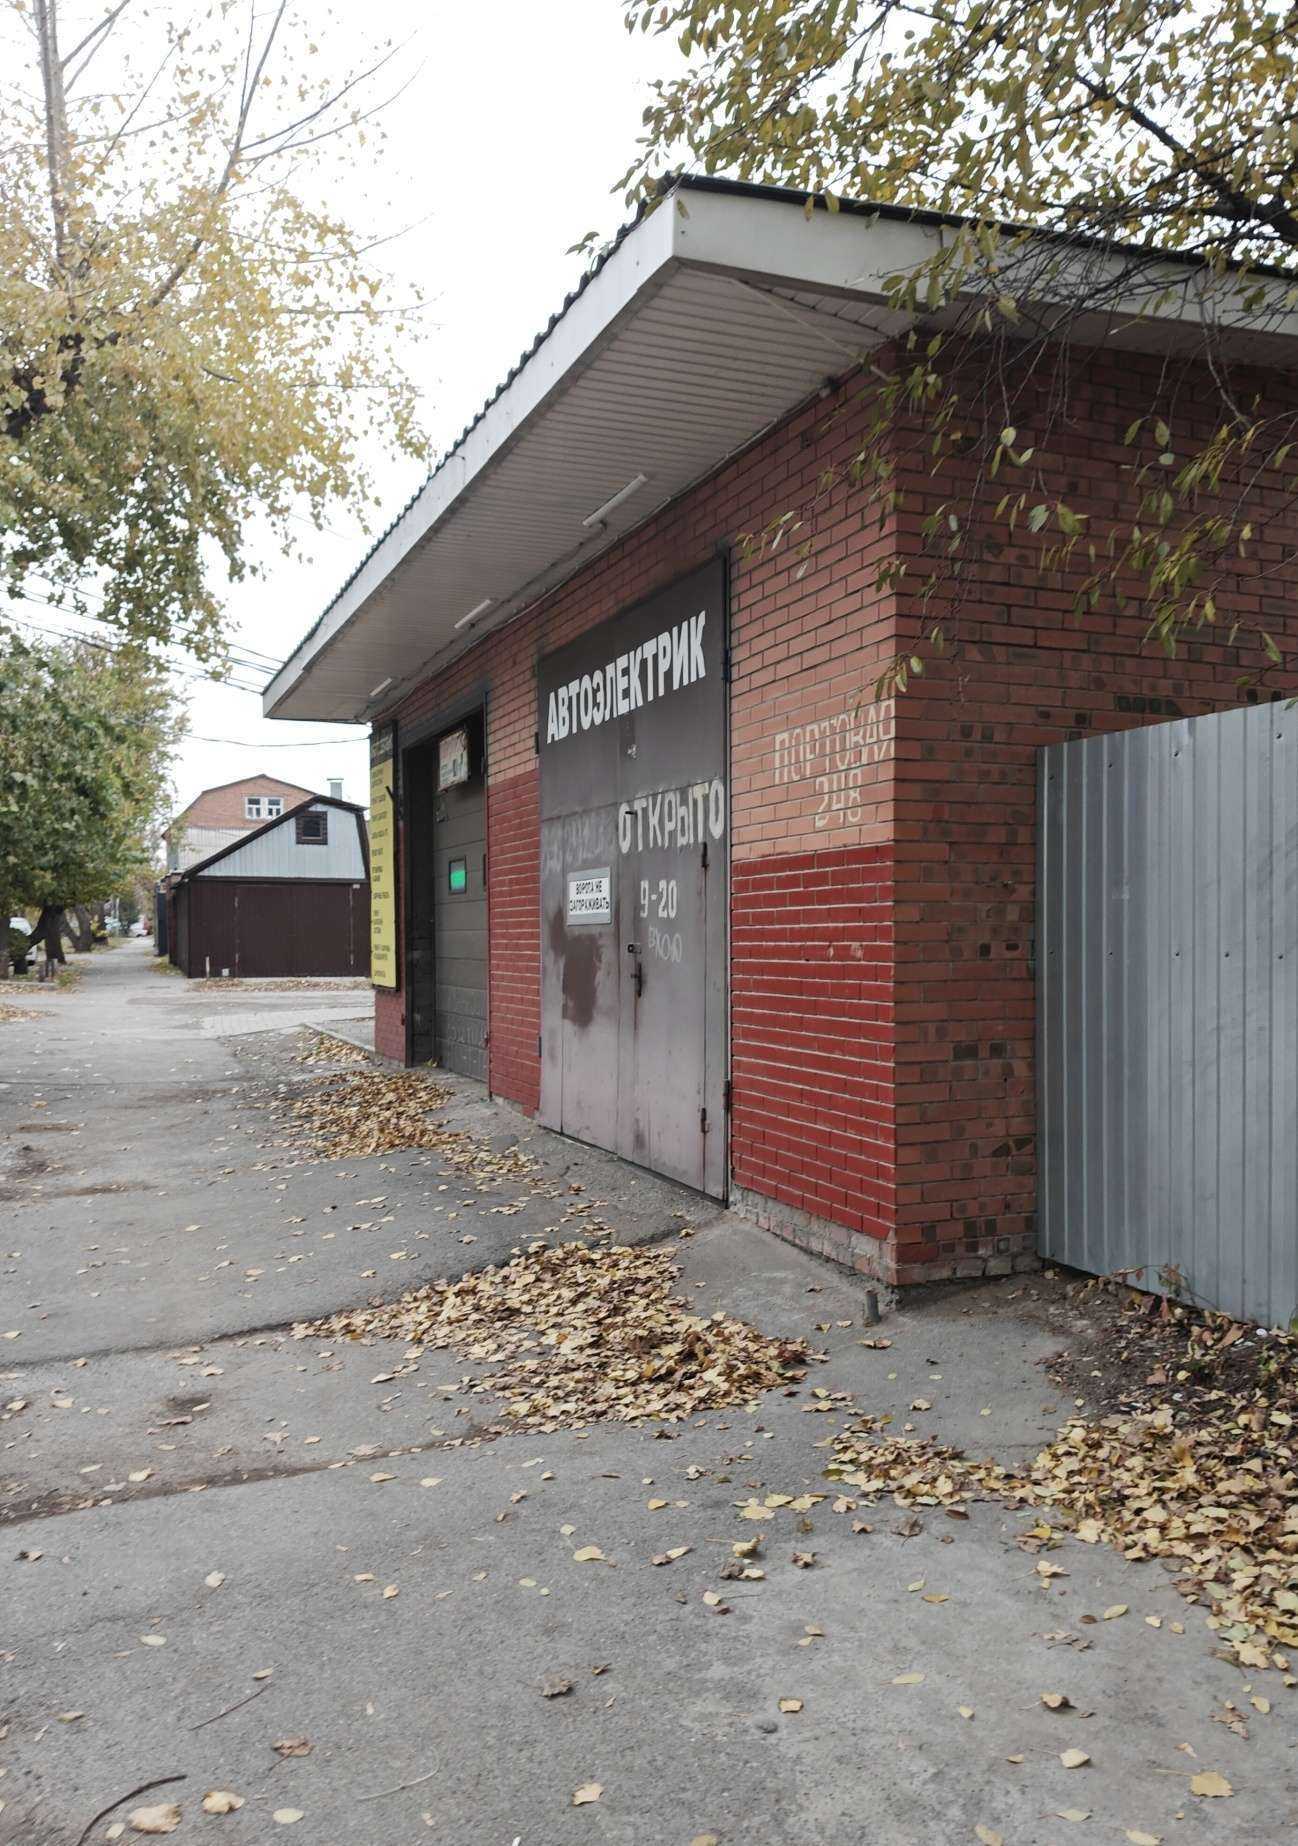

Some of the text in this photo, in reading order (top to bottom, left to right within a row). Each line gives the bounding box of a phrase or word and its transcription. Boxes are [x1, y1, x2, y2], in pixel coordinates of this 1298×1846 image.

[547, 610, 706, 744] АВТОЭЛЕКТРИК
[618, 779, 725, 854] ОТКРЫТО
[640, 879, 678, 918] 9-20
